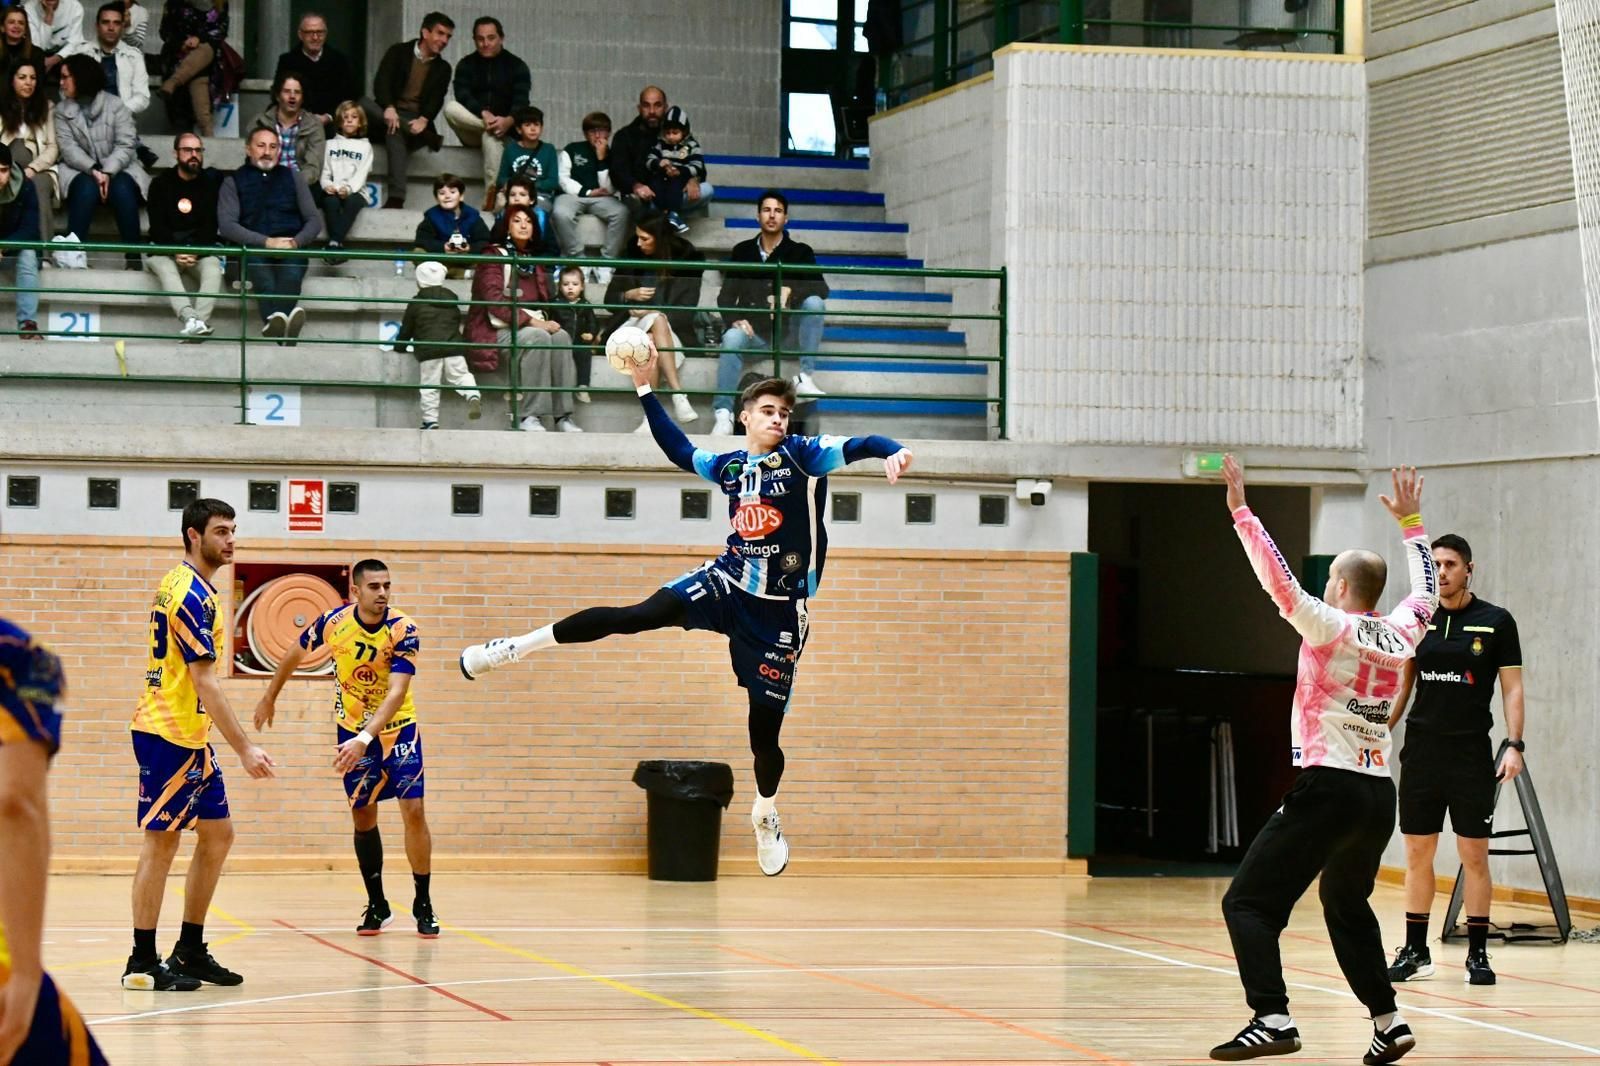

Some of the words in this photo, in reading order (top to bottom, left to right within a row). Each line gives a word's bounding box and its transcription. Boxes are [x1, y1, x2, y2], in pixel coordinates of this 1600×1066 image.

[60, 312, 90, 338] 21
[265, 393, 285, 421] 2
[1416, 542, 1434, 594] MICHELIN
[685, 581, 708, 602] 11
[150, 610, 168, 660] 3
[355, 641, 378, 662] 77
[759, 663, 780, 680] GO
[1420, 670, 1462, 682] helvetia
